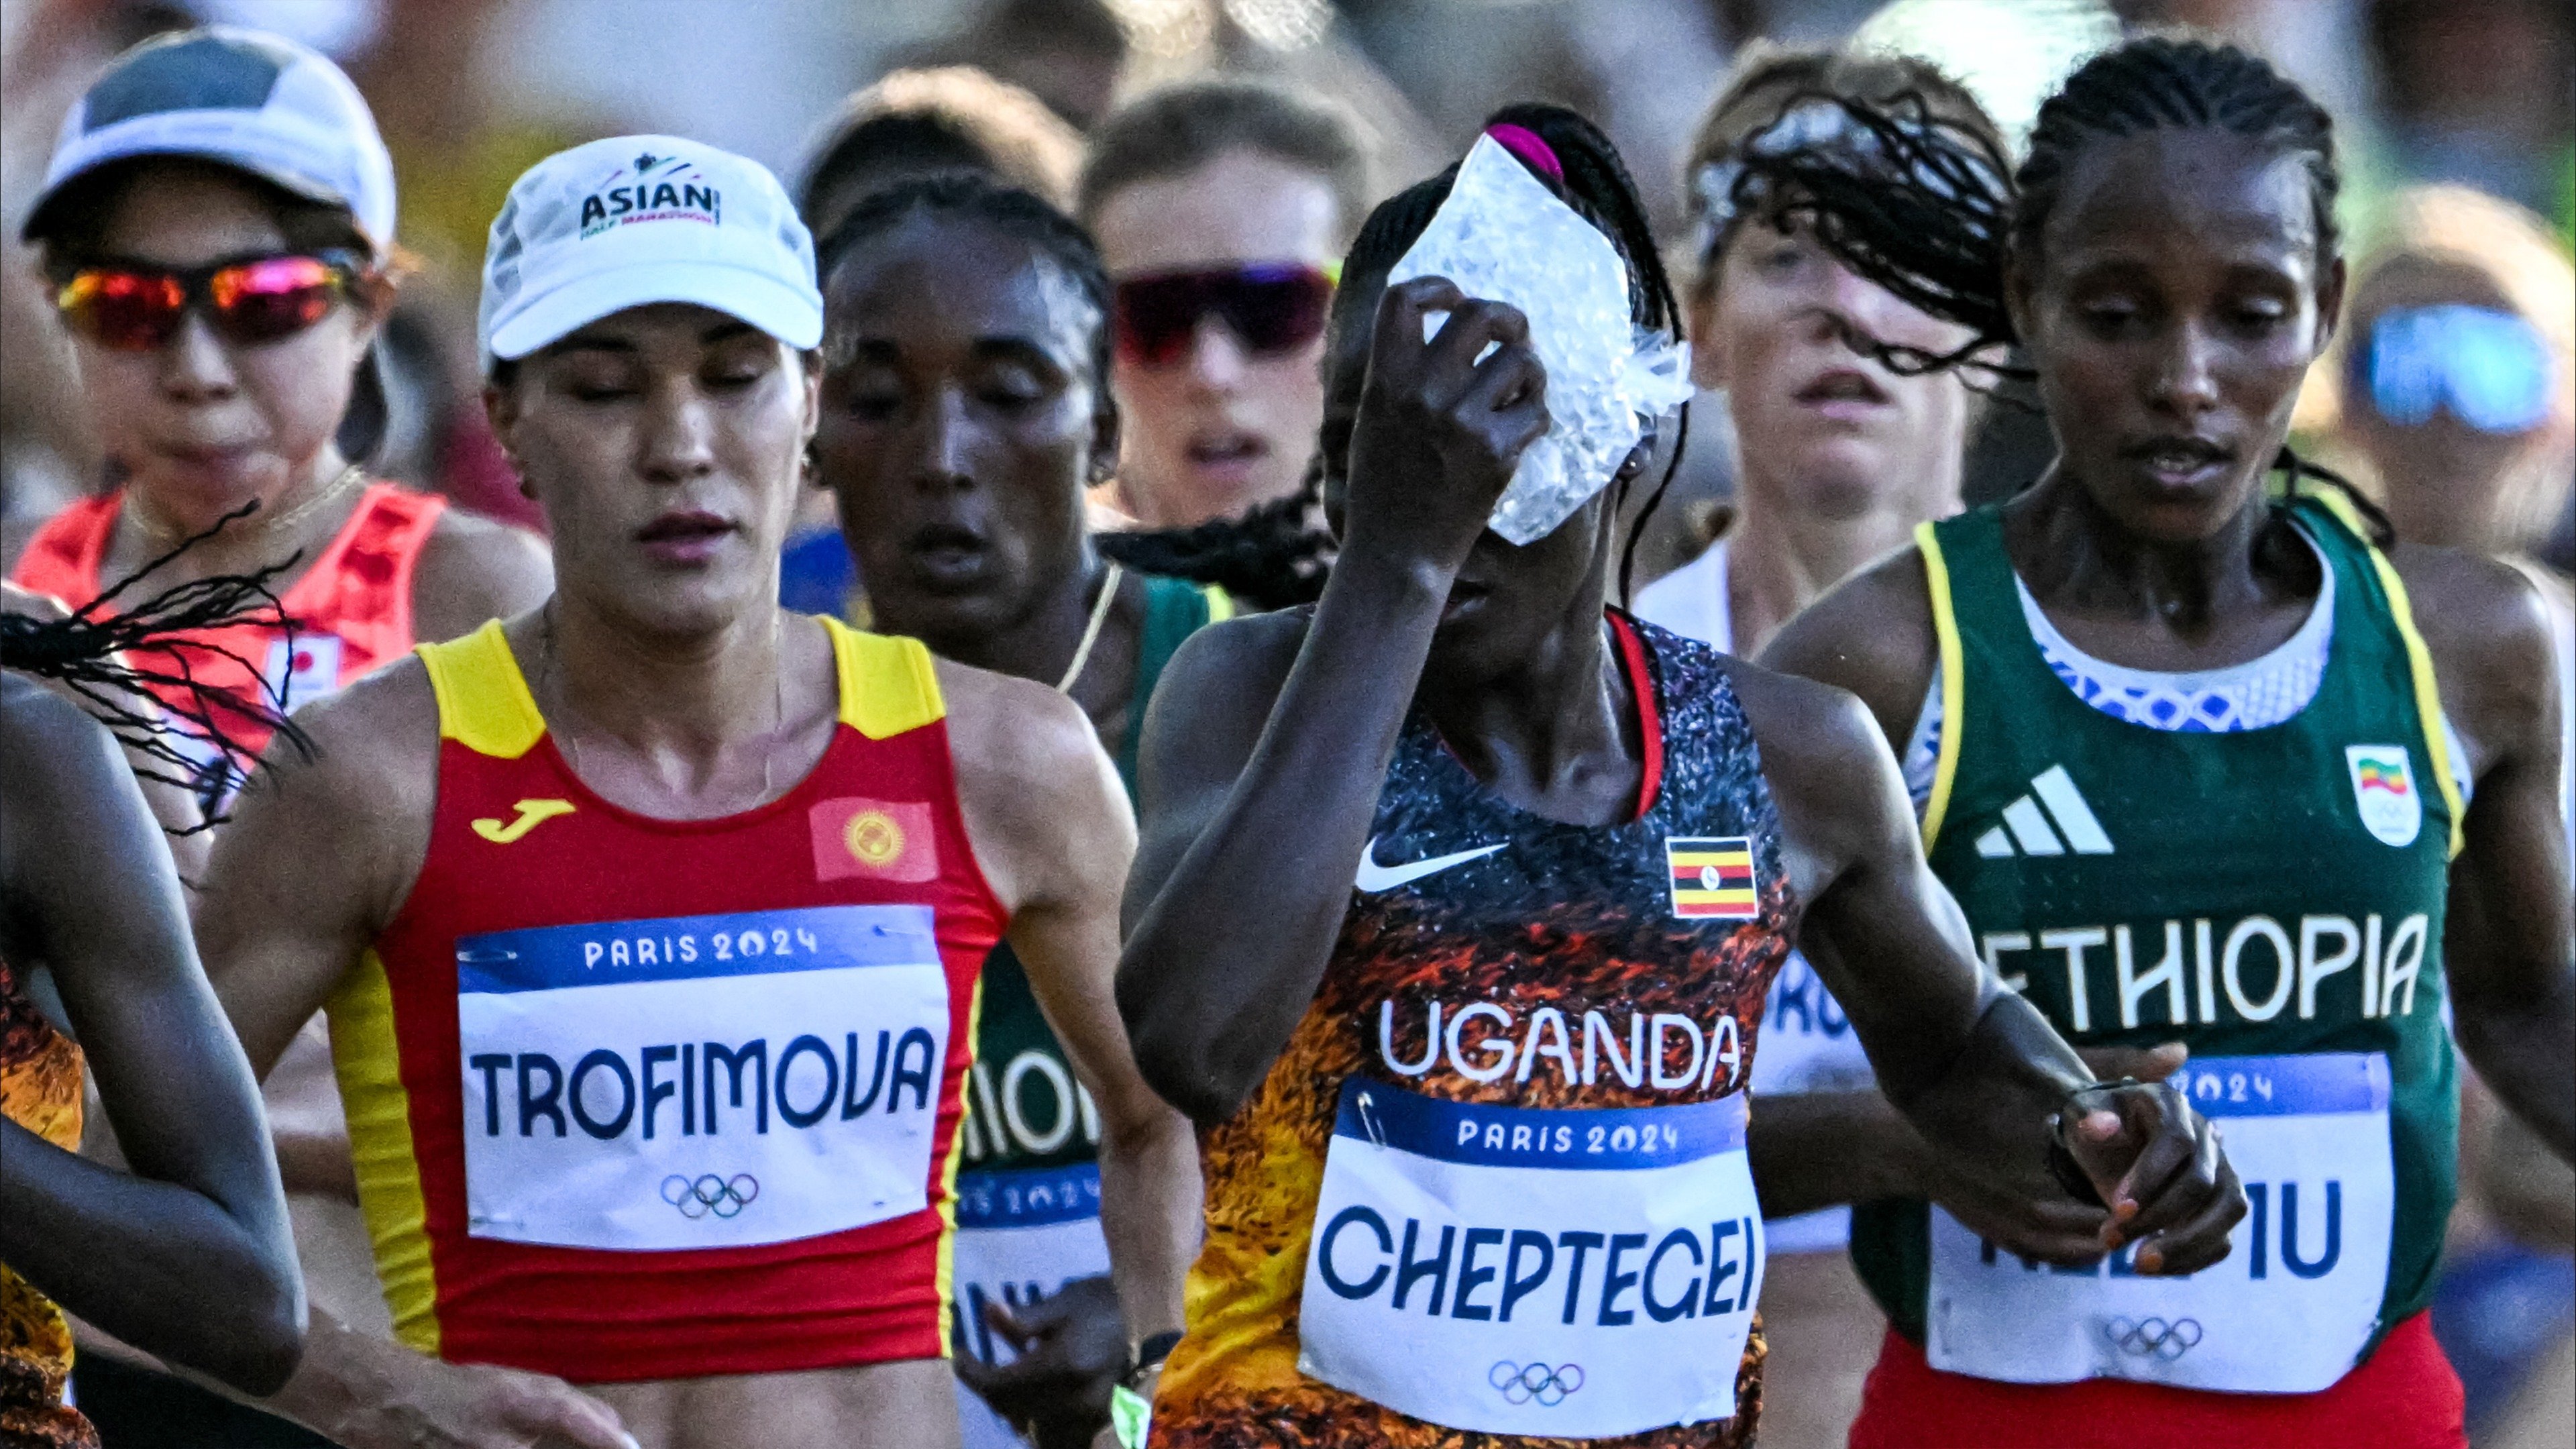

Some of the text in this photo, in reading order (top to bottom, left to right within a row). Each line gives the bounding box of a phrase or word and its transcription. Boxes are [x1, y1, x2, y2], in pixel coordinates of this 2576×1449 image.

[581, 183, 712, 229] ASIAN
[584, 927, 817, 970] PARIS 2024
[1379, 1000, 1741, 1090] UGANDA
[470, 1026, 935, 1140] TROFIMOVA
[1457, 1118, 1678, 1154] PARIS 2024
[1318, 1204, 1756, 1327] CHEPTEGEI
